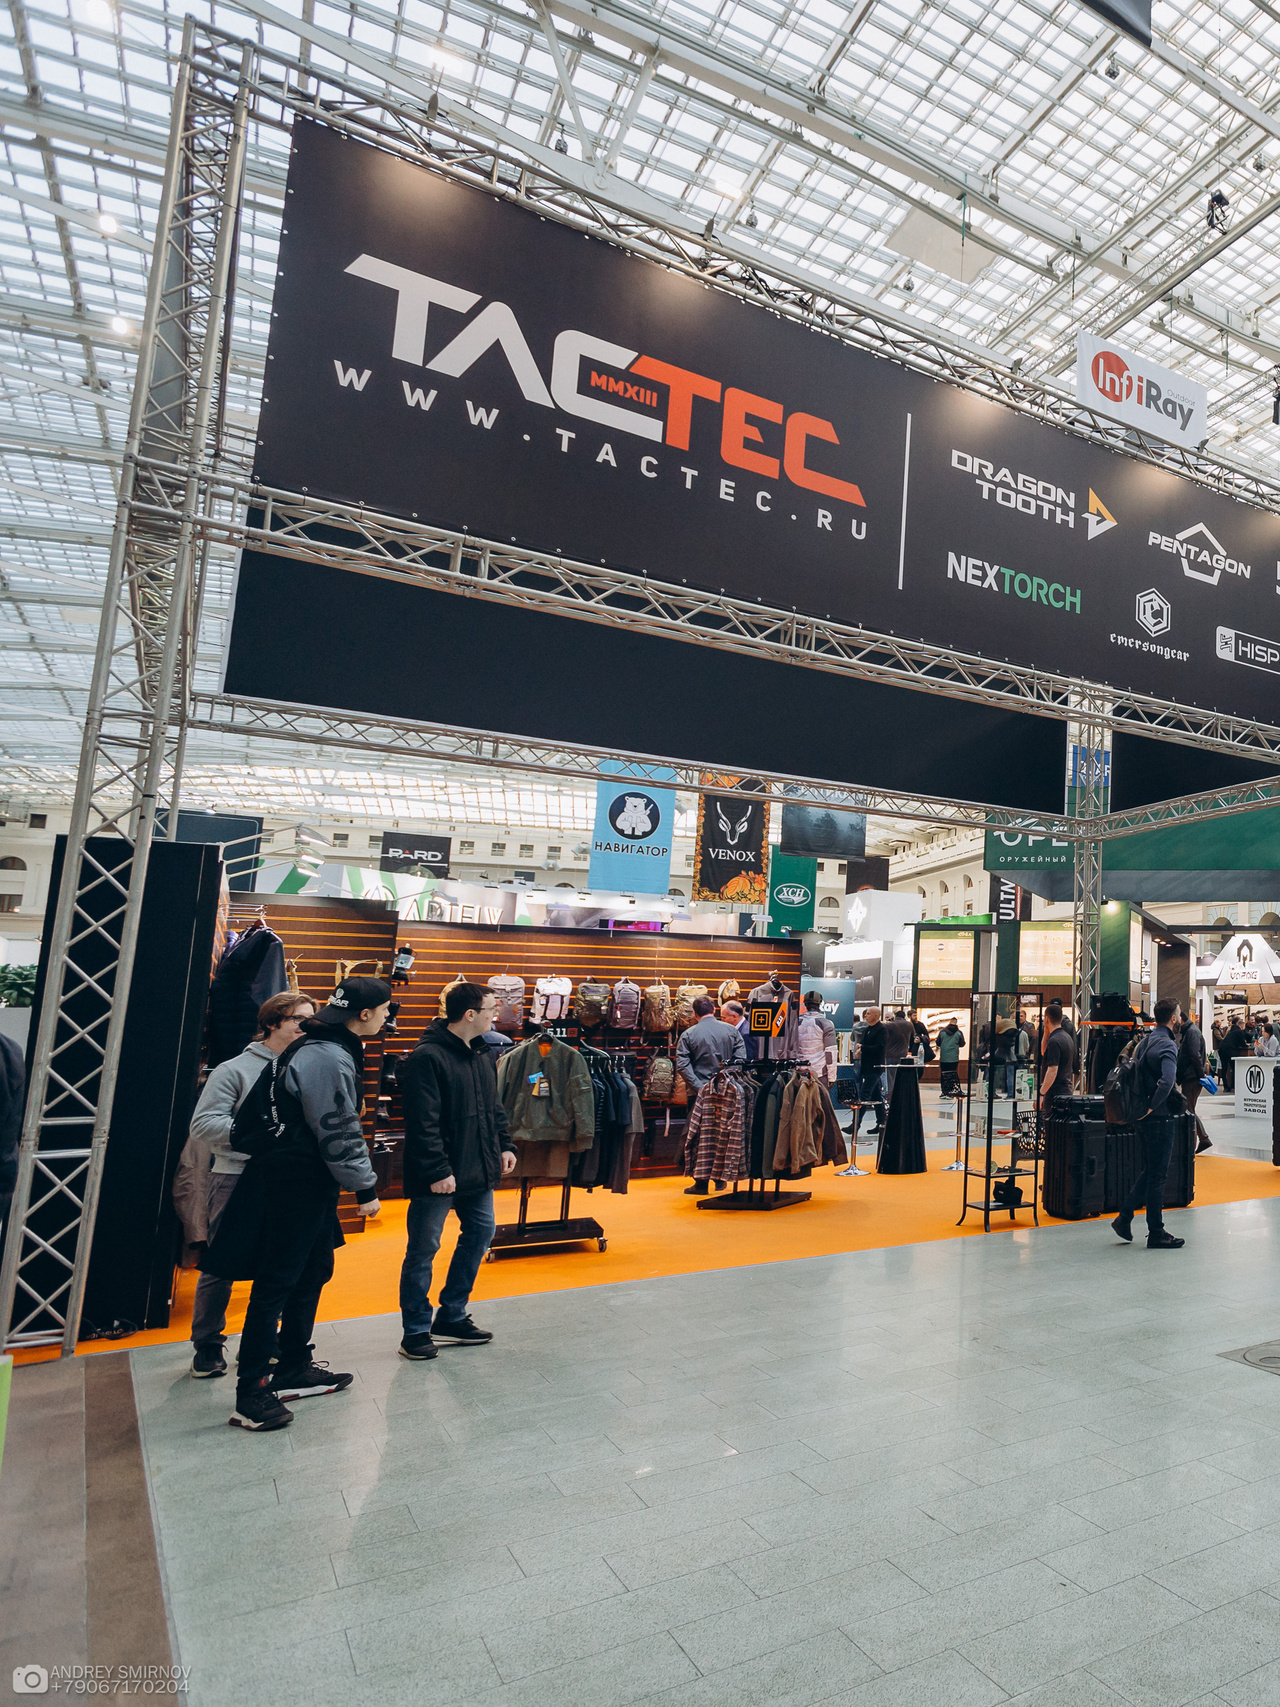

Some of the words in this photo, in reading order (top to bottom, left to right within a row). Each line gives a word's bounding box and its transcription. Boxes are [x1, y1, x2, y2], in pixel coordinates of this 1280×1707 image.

[344, 253, 867, 507] TACTEC
[590, 371, 657, 408] MMXIII
[1167, 389, 1196, 406] Outdoor
[951, 447, 1075, 508] DRAGON
[975, 479, 1075, 529] TOOTH
[1148, 530, 1252, 579] PENTAGON
[947, 551, 1081, 614] NEXTORCH
[1110, 633, 1190, 661] emersongear
[388, 848, 442, 861] PARD
[594, 841, 668, 857] НАВИГАТОР
[708, 847, 756, 862] VENOX
[999, 855, 1067, 863] ОРУЖЕЙНЫЙ
